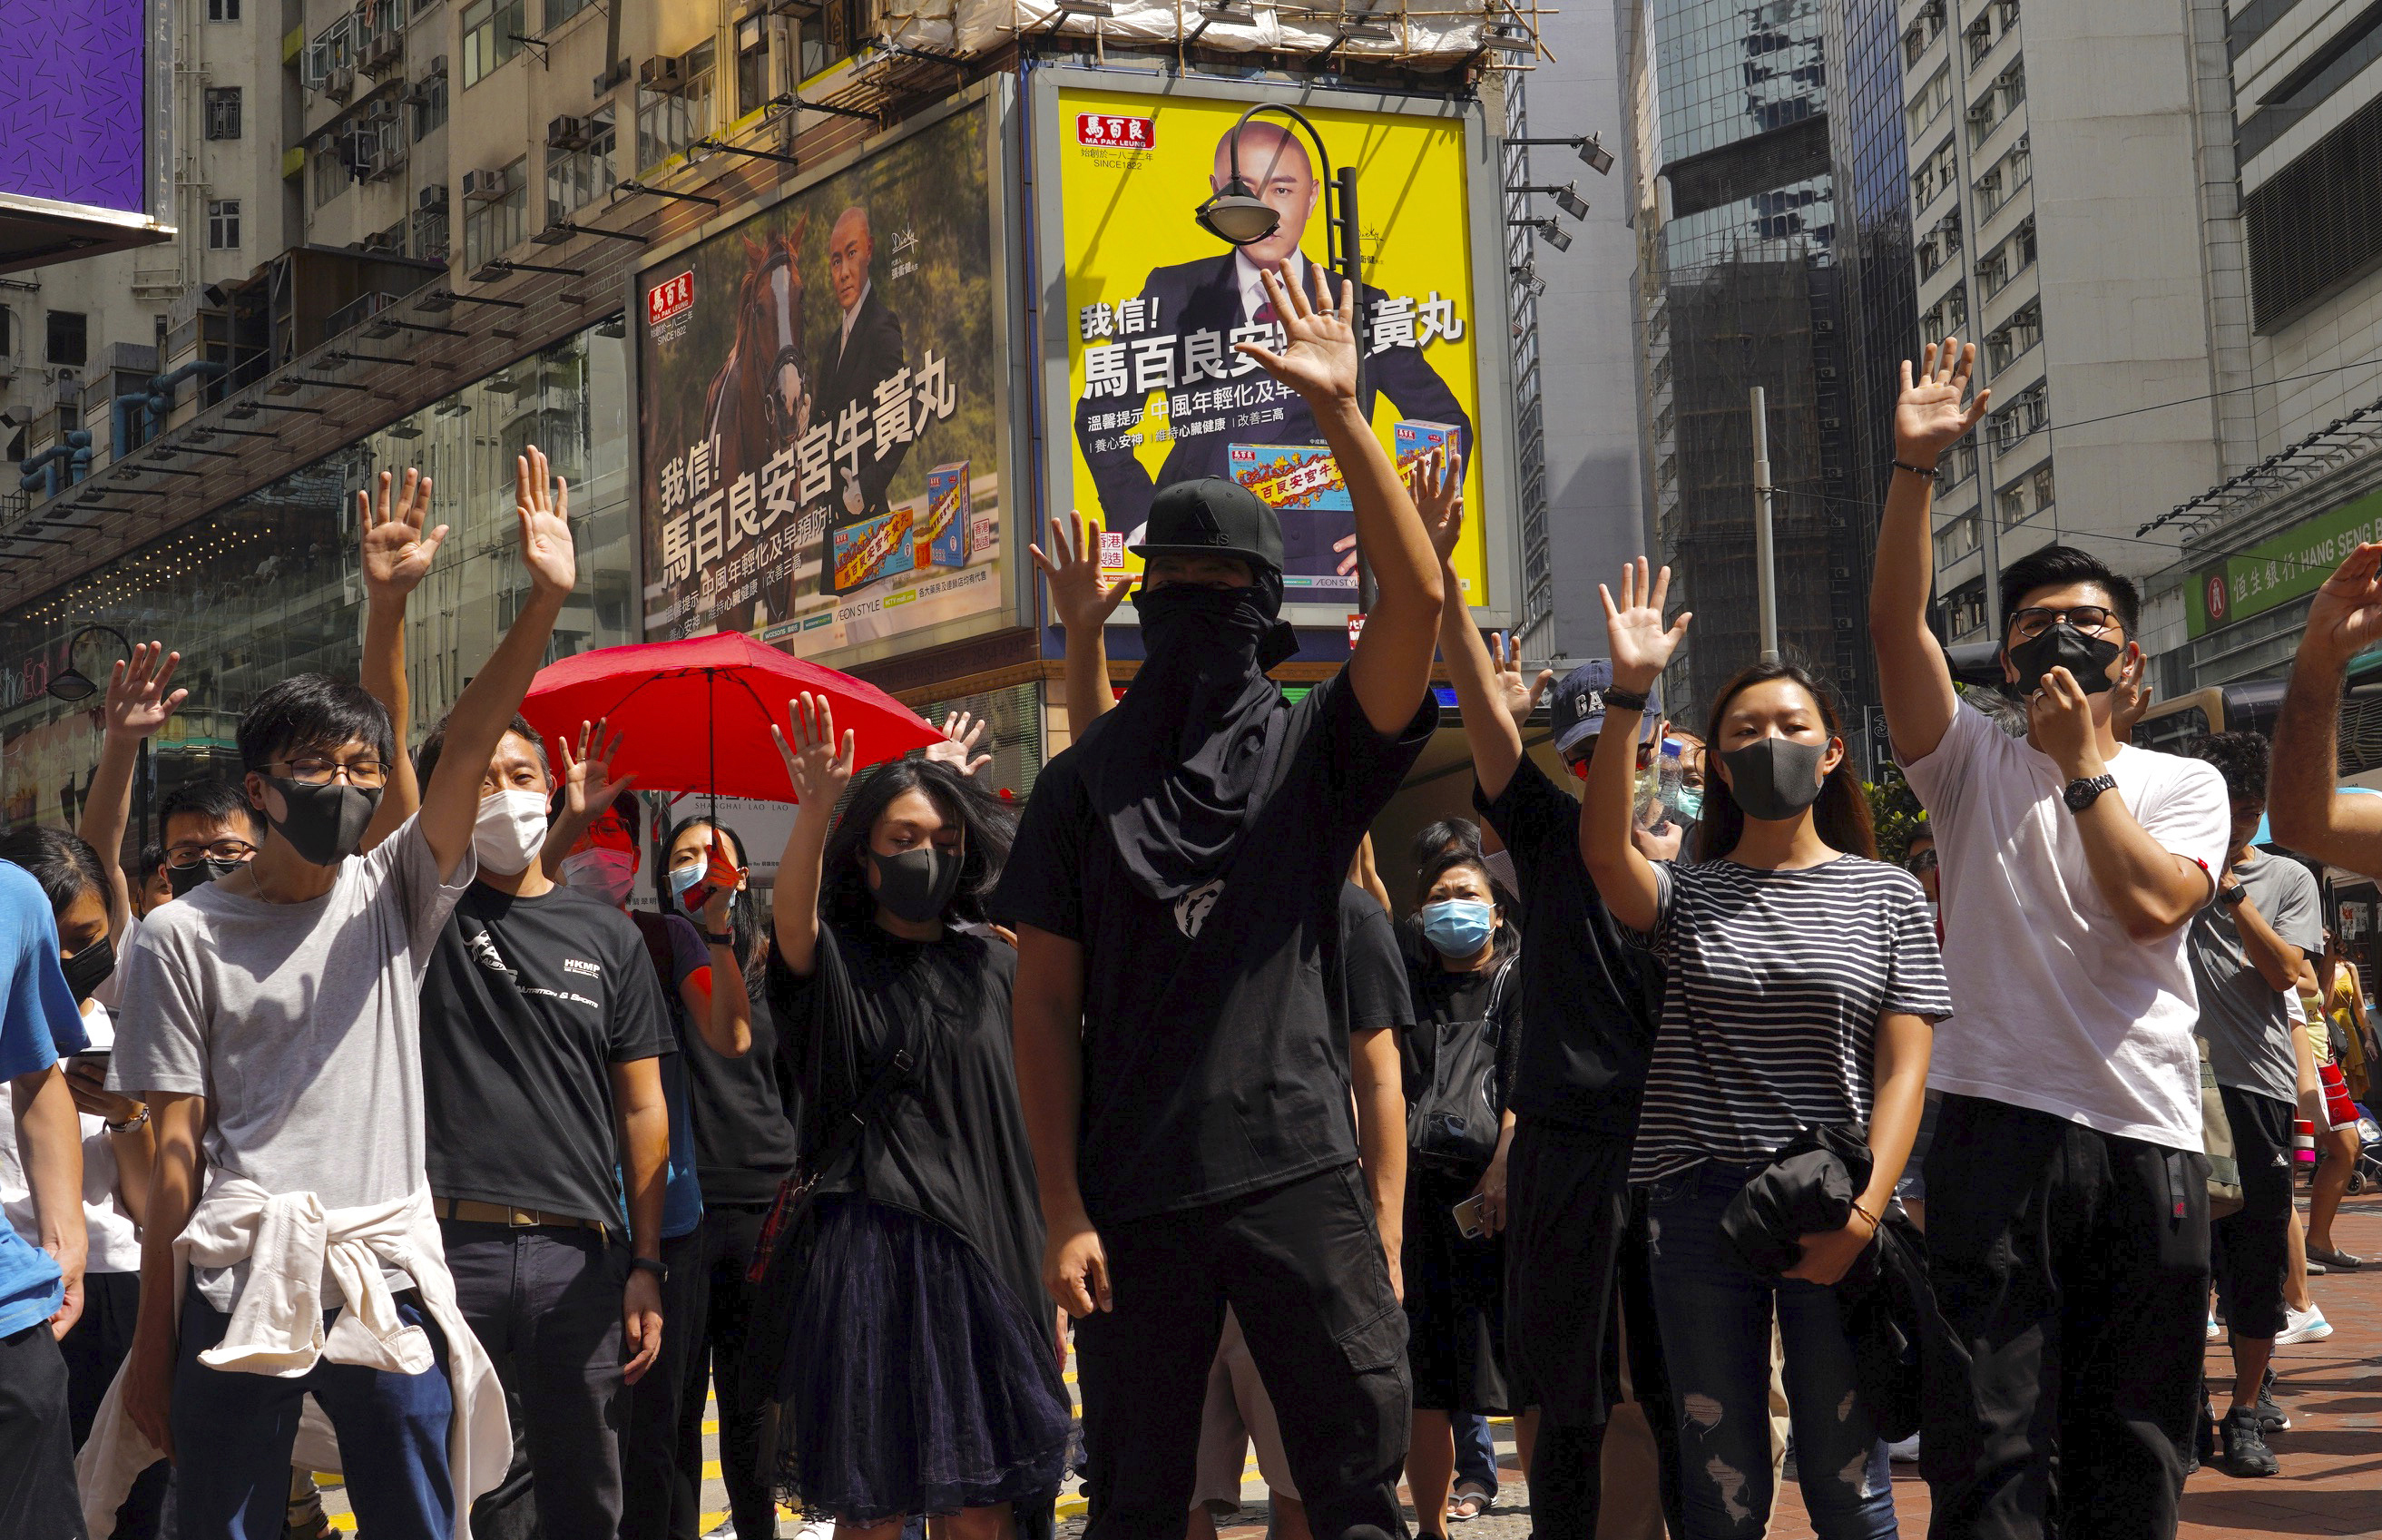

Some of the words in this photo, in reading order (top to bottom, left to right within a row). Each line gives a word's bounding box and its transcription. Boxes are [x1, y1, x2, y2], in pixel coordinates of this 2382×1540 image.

[1085, 115, 1145, 140] 馬百良
[1081, 148, 1154, 162] 始創於一八二二年
[1120, 140, 1146, 148] LEUNG
[1093, 159, 1142, 170] SINCE1822
[653, 278, 689, 312] 馬百良
[662, 308, 671, 318] PAK
[672, 299, 689, 312] LEUNG
[1081, 297, 1159, 339] 我信!
[658, 325, 687, 346] SINCE1822
[1082, 290, 1463, 399] 馬百良安黃丸
[1150, 375, 1302, 421] 中風年輕化及早
[1238, 407, 1284, 428] 改善三高
[661, 348, 956, 591] 馬百良安宮牛黃丸
[661, 433, 721, 515] 我信!
[1252, 462, 1340, 499] 百良安宮牛
[2300, 539, 2334, 574] HANG
[2338, 523, 2371, 557] SENG
[766, 552, 802, 587] 改善三高
[1339, 577, 1358, 587] STYL
[858, 599, 880, 616] STYLE
[1574, 688, 1612, 718] GA
[695, 802, 742, 810] SHANGHAI
[772, 804, 789, 812] LAO
[564, 958, 601, 972] HKMP
[559, 991, 568, 999] &
